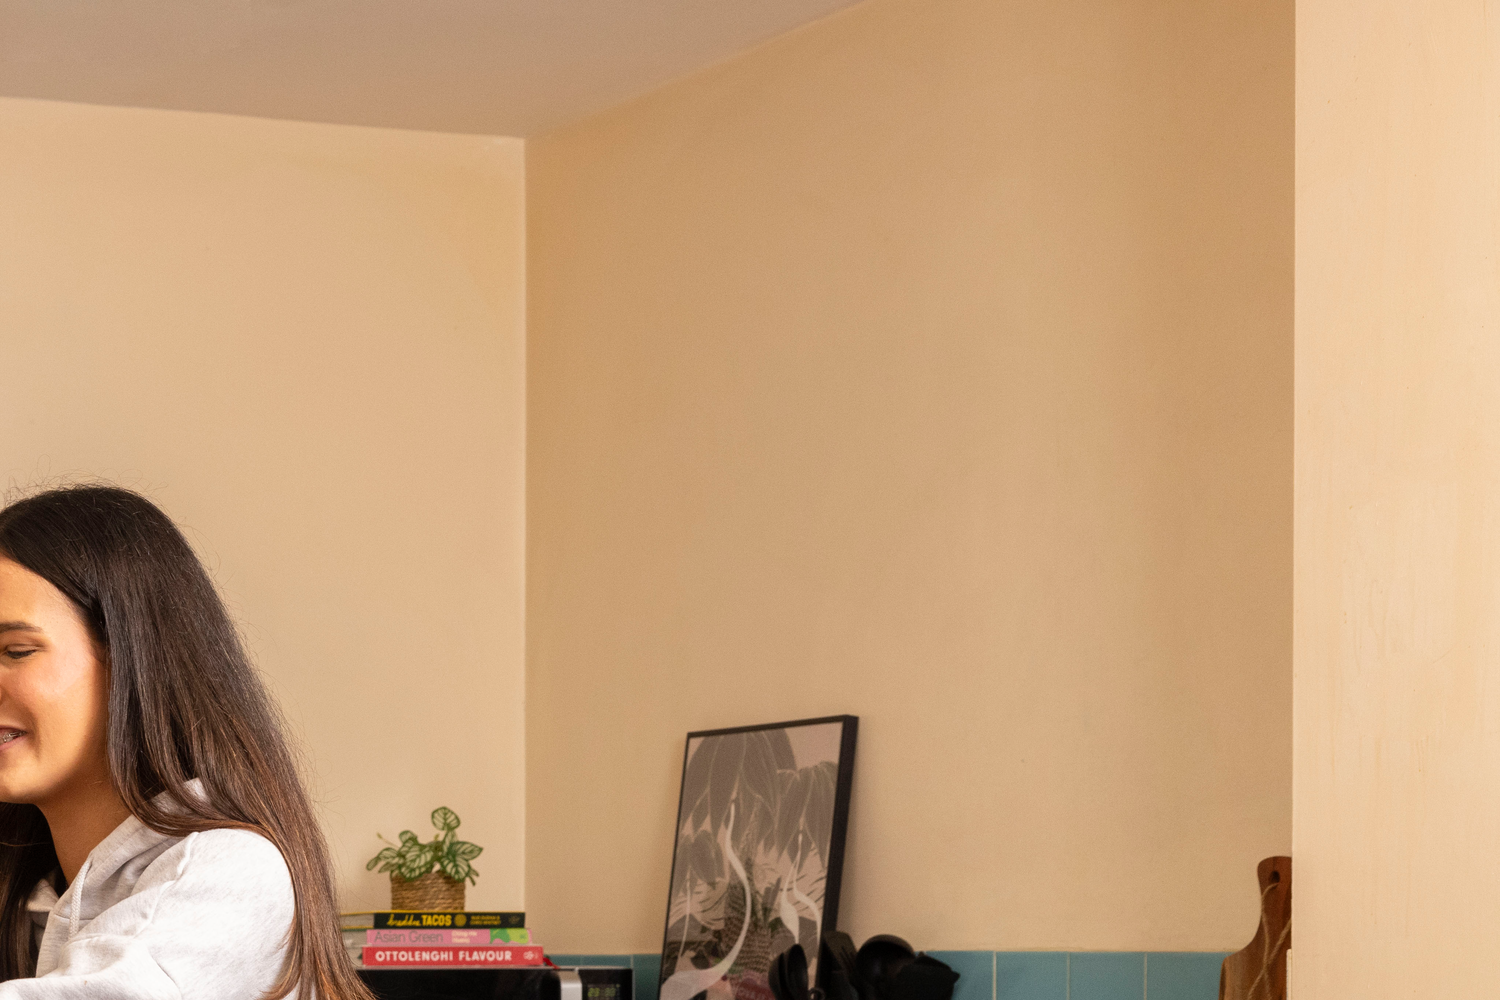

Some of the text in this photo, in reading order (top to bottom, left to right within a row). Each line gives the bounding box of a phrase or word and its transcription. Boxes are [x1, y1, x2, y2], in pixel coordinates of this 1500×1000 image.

[421, 914, 452, 926] TACOS
[374, 931, 405, 943] Asian
[408, 931, 444, 943] Green
[375, 950, 512, 961] OTTOLENGHI FLAVOUR
